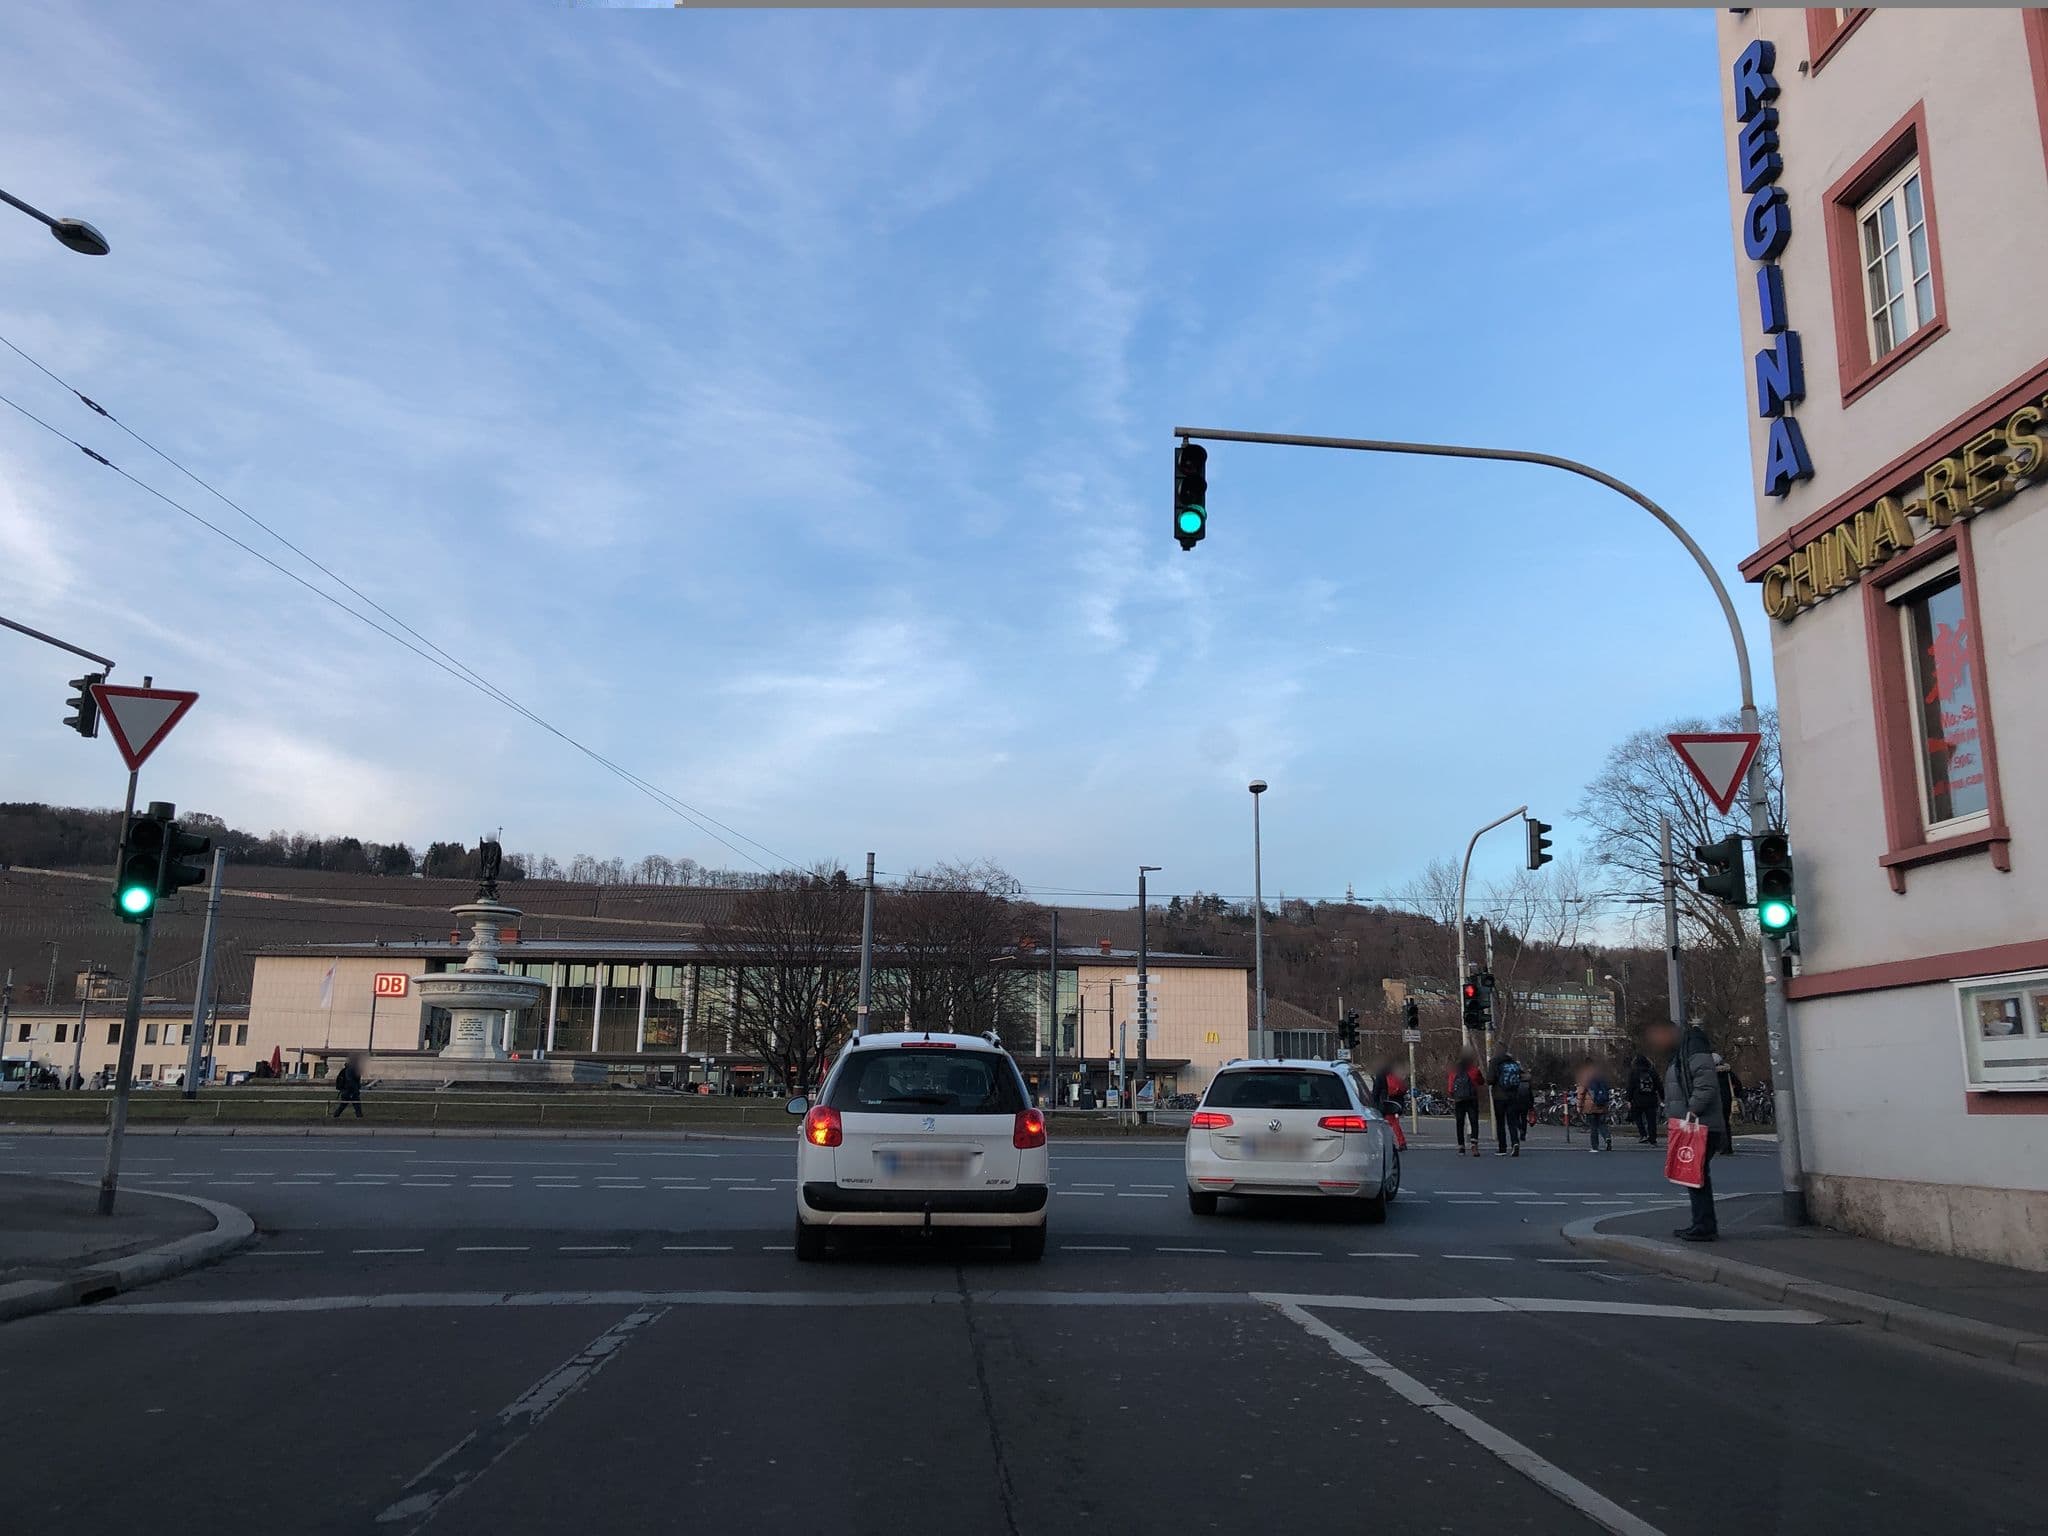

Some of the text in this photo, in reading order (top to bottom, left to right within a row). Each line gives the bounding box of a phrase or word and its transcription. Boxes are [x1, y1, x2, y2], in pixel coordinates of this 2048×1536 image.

[1733, 40, 1813, 496] REGINA
[1762, 395, 2048, 622] CHINA-RES
[378, 977, 402, 993] DB
